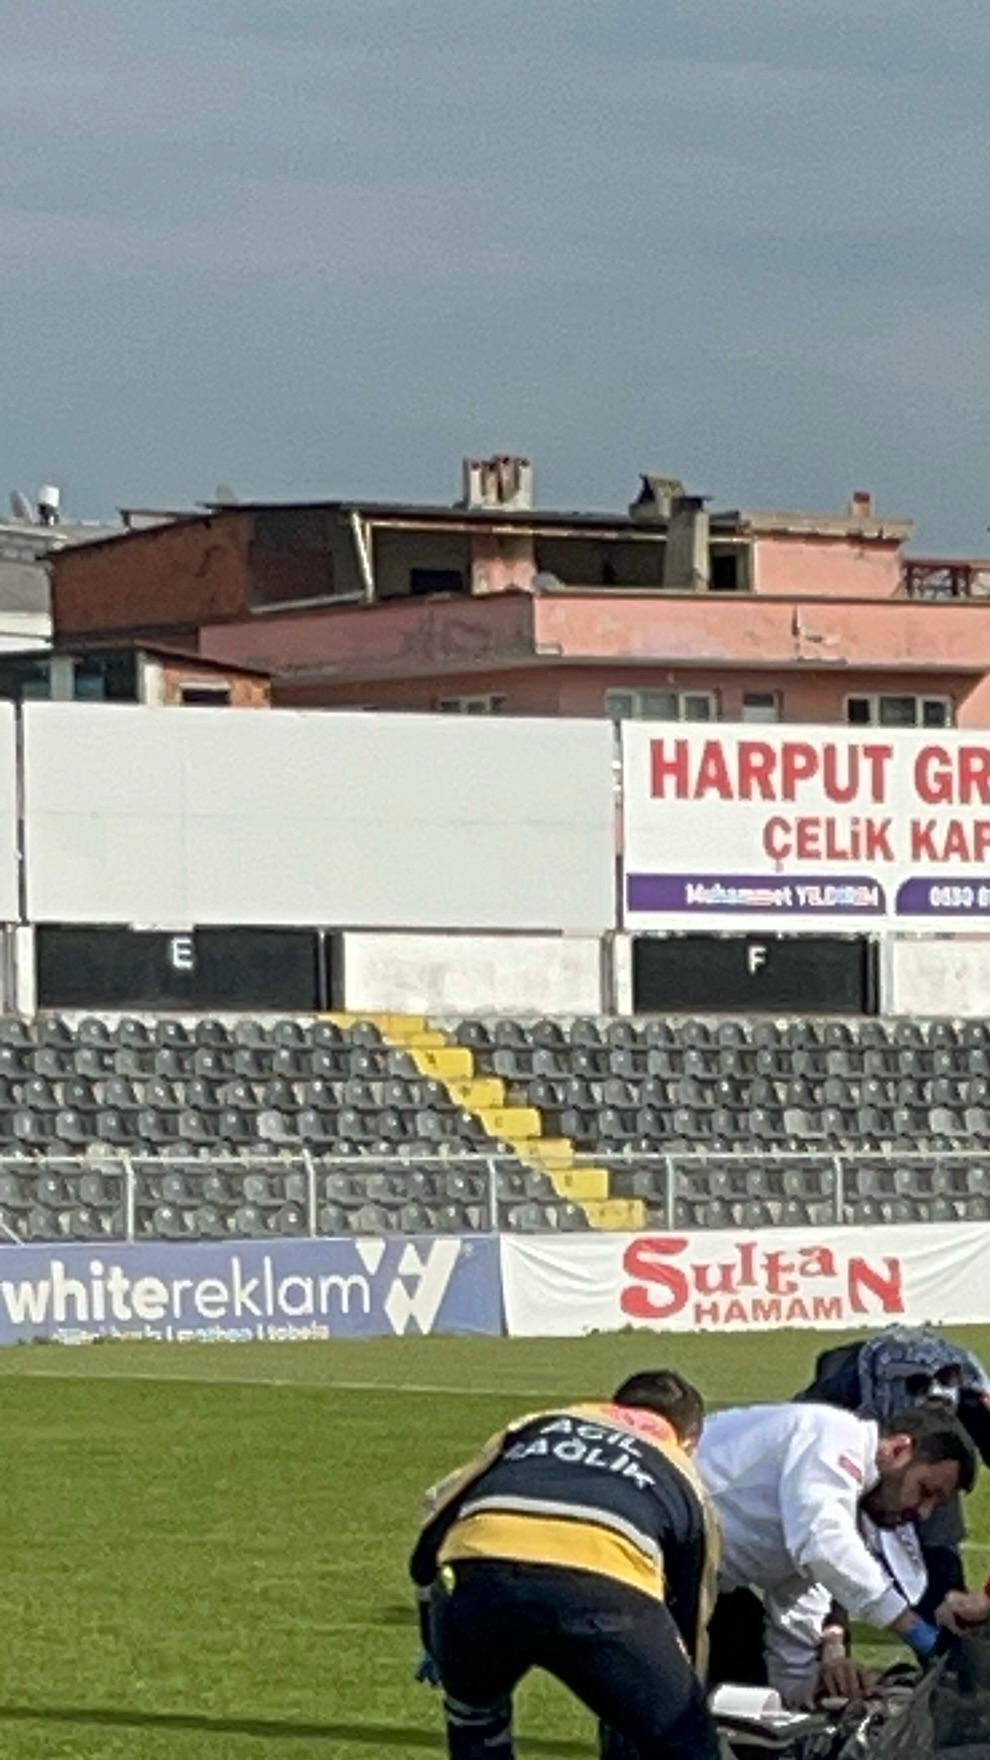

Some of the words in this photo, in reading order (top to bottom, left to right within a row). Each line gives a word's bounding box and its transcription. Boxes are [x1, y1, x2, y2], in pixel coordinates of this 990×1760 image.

[649, 738, 893, 804] HARPUT
[172, 937, 193, 968] E
[749, 945, 767, 973] F
[0, 1256, 371, 1324] whitereklam
[694, 1297, 843, 1324] HAMAM
